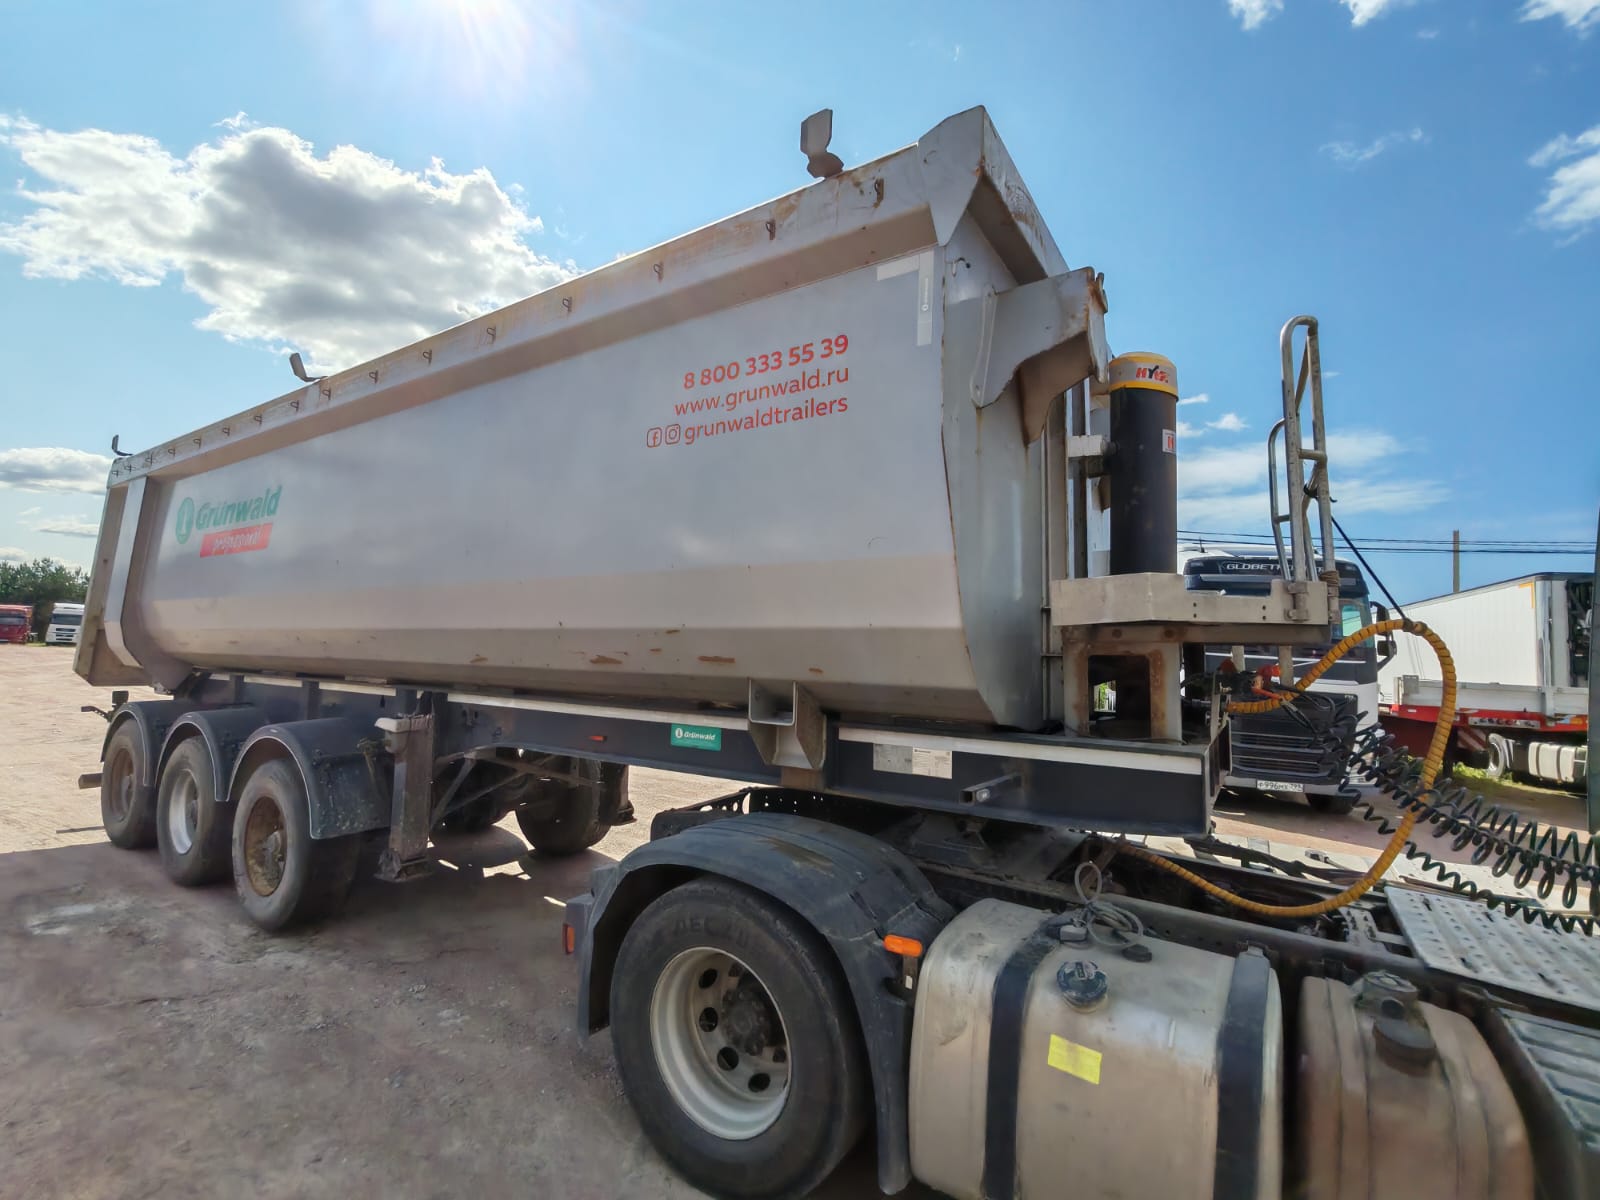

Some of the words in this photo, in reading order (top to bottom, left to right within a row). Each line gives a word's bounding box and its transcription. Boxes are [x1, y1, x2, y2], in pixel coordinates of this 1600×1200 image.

[683, 372, 695, 390] 8
[700, 361, 740, 386] 800
[745, 351, 782, 376] 333
[788, 343, 814, 367] 55
[820, 334, 849, 359] 39
[674, 367, 849, 417] www.grunwald.ru
[684, 397, 848, 445] grunwaldtrailers
